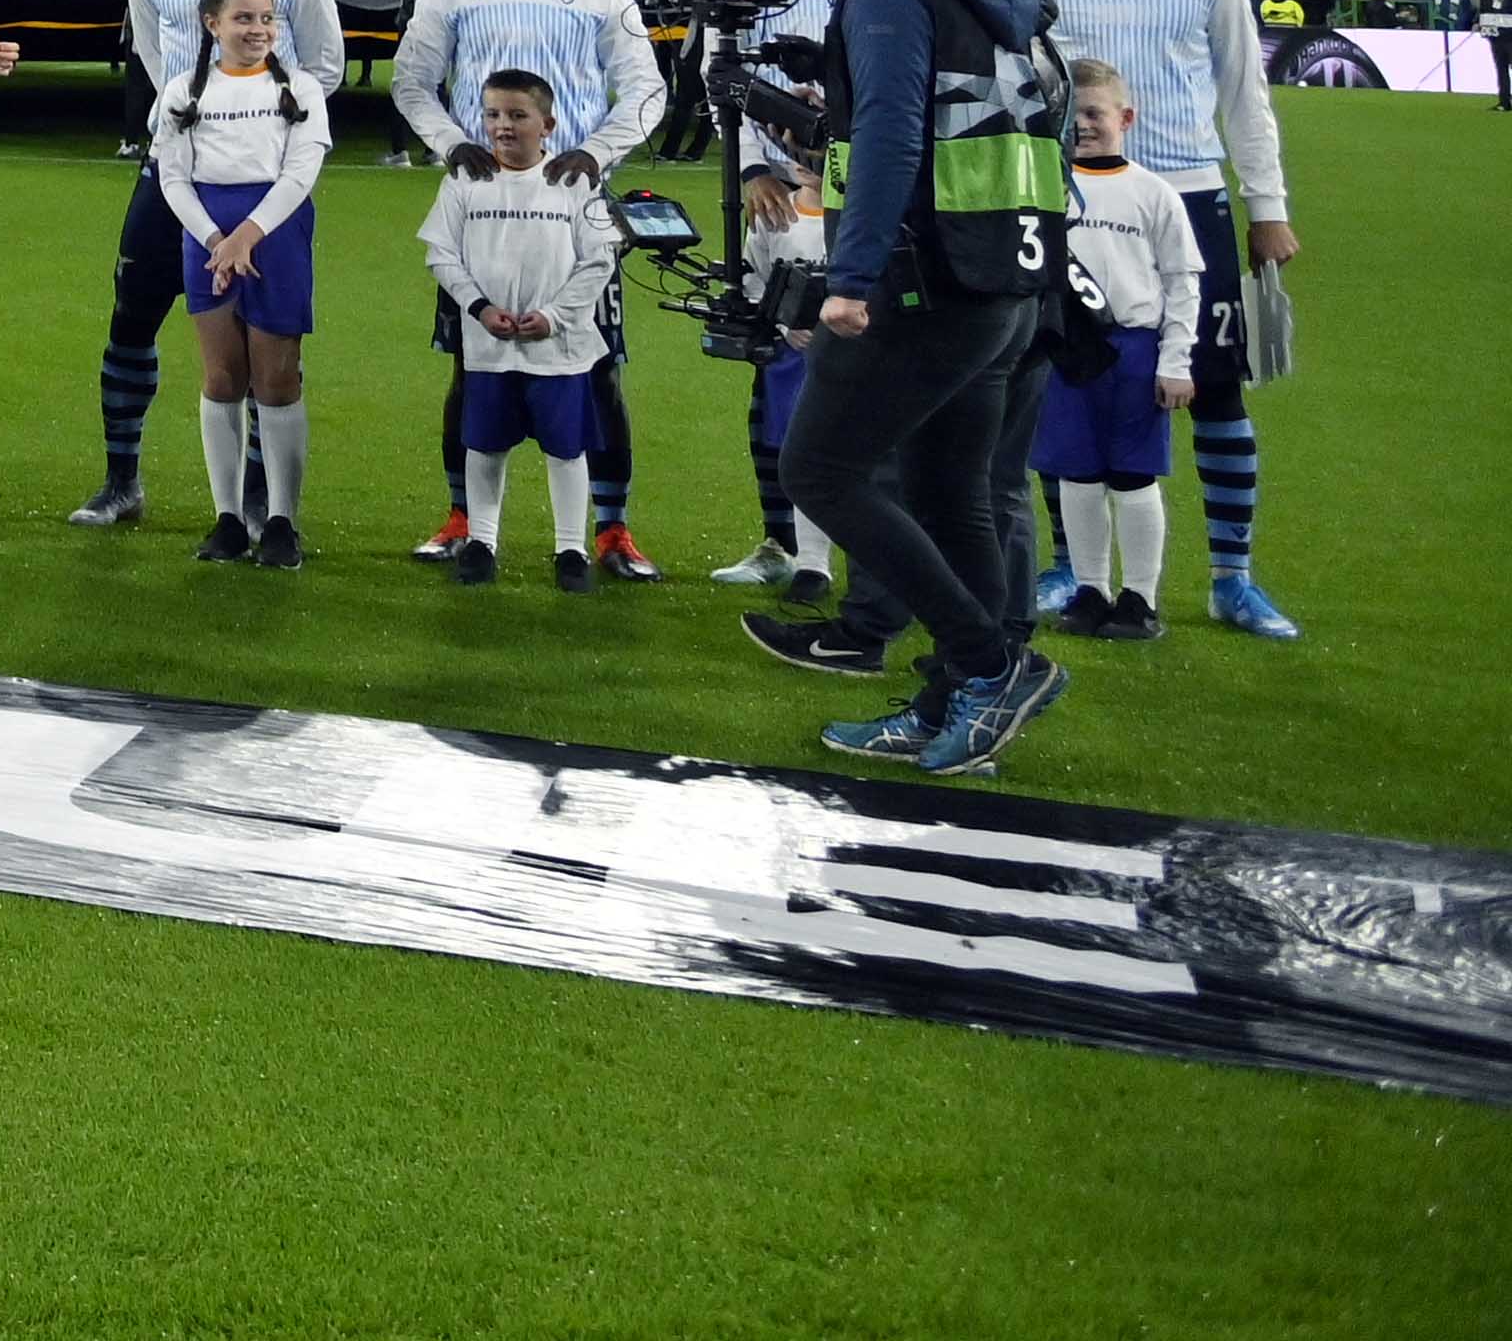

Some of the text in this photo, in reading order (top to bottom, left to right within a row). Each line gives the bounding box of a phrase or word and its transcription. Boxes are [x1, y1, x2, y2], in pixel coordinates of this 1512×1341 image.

[1017, 215, 1044, 270] 3
[597, 283, 621, 326] 15
[1067, 263, 1106, 310] 5
[1212, 300, 1245, 347] 21
